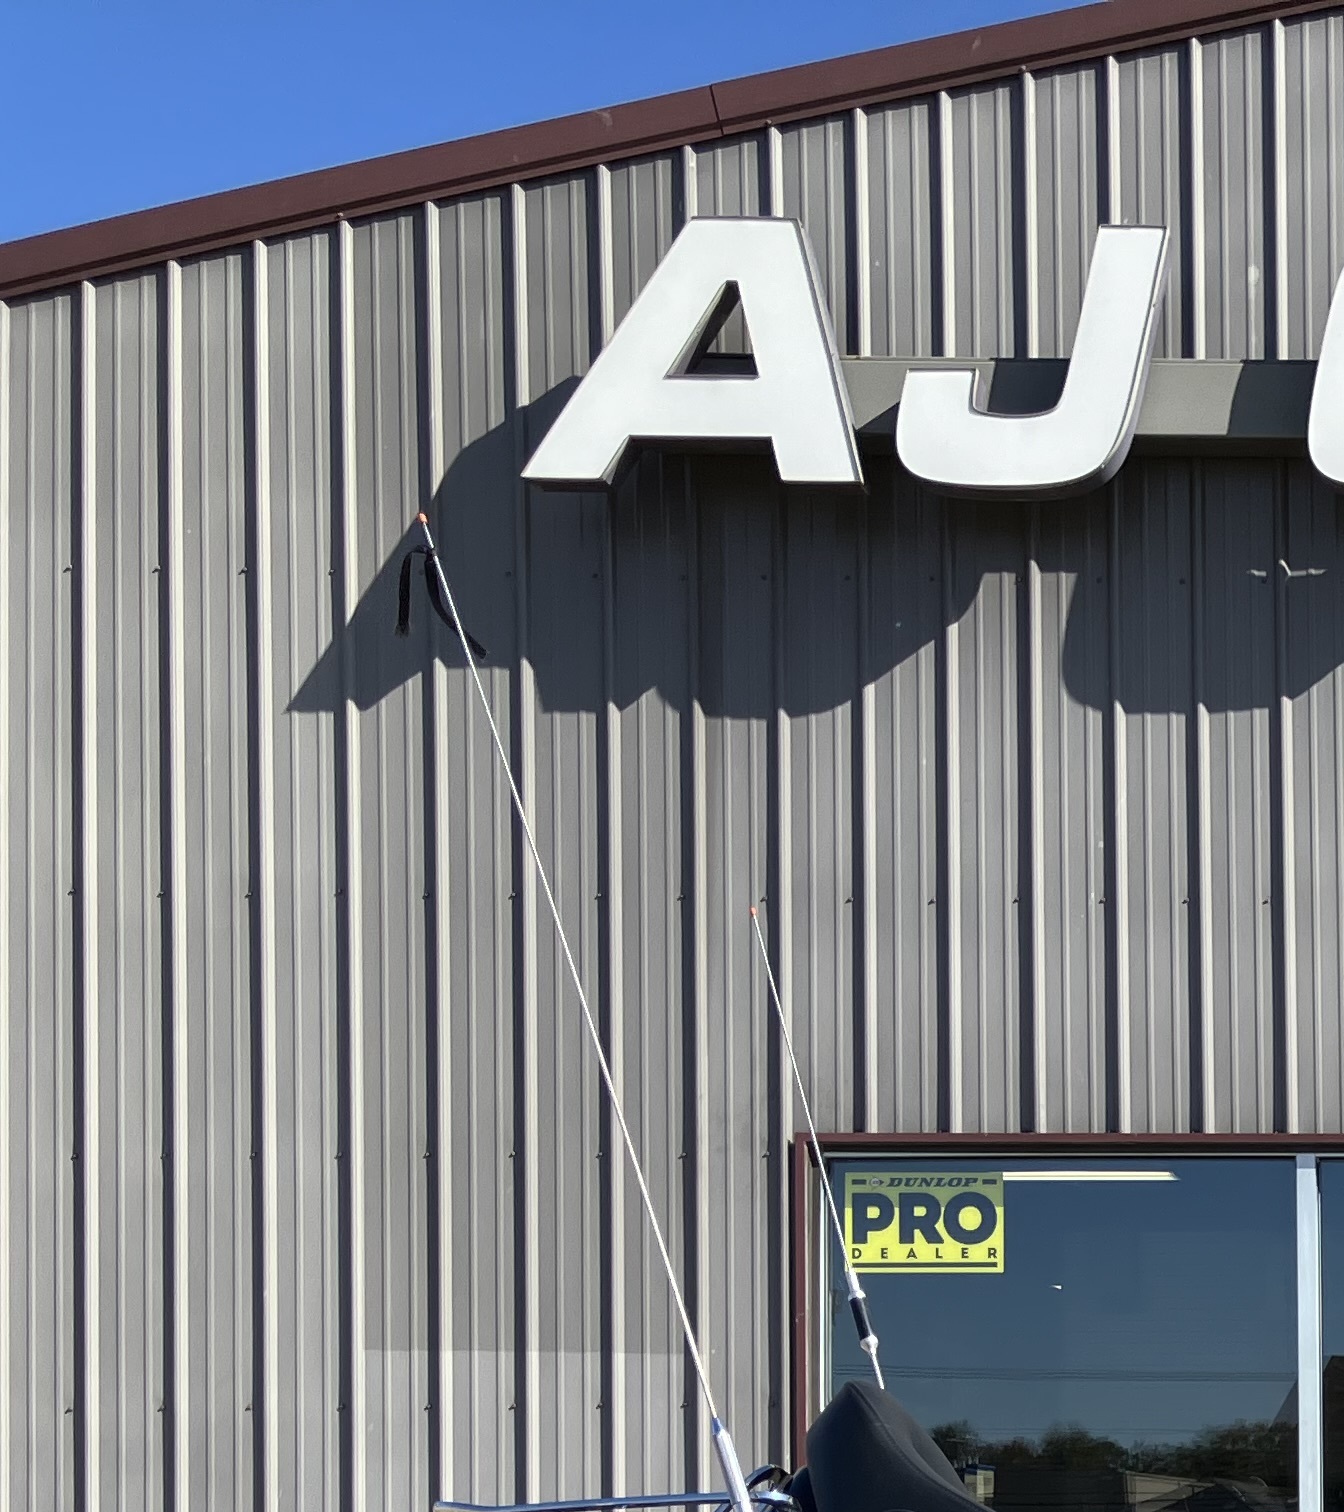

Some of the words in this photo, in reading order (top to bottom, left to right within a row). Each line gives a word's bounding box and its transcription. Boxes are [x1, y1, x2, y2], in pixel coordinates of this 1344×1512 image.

[522, 216, 1168, 488] AJ
[886, 1177, 979, 1188] DUNLOP
[852, 1191, 998, 1245] PRO
[852, 1247, 998, 1259] DEALER
